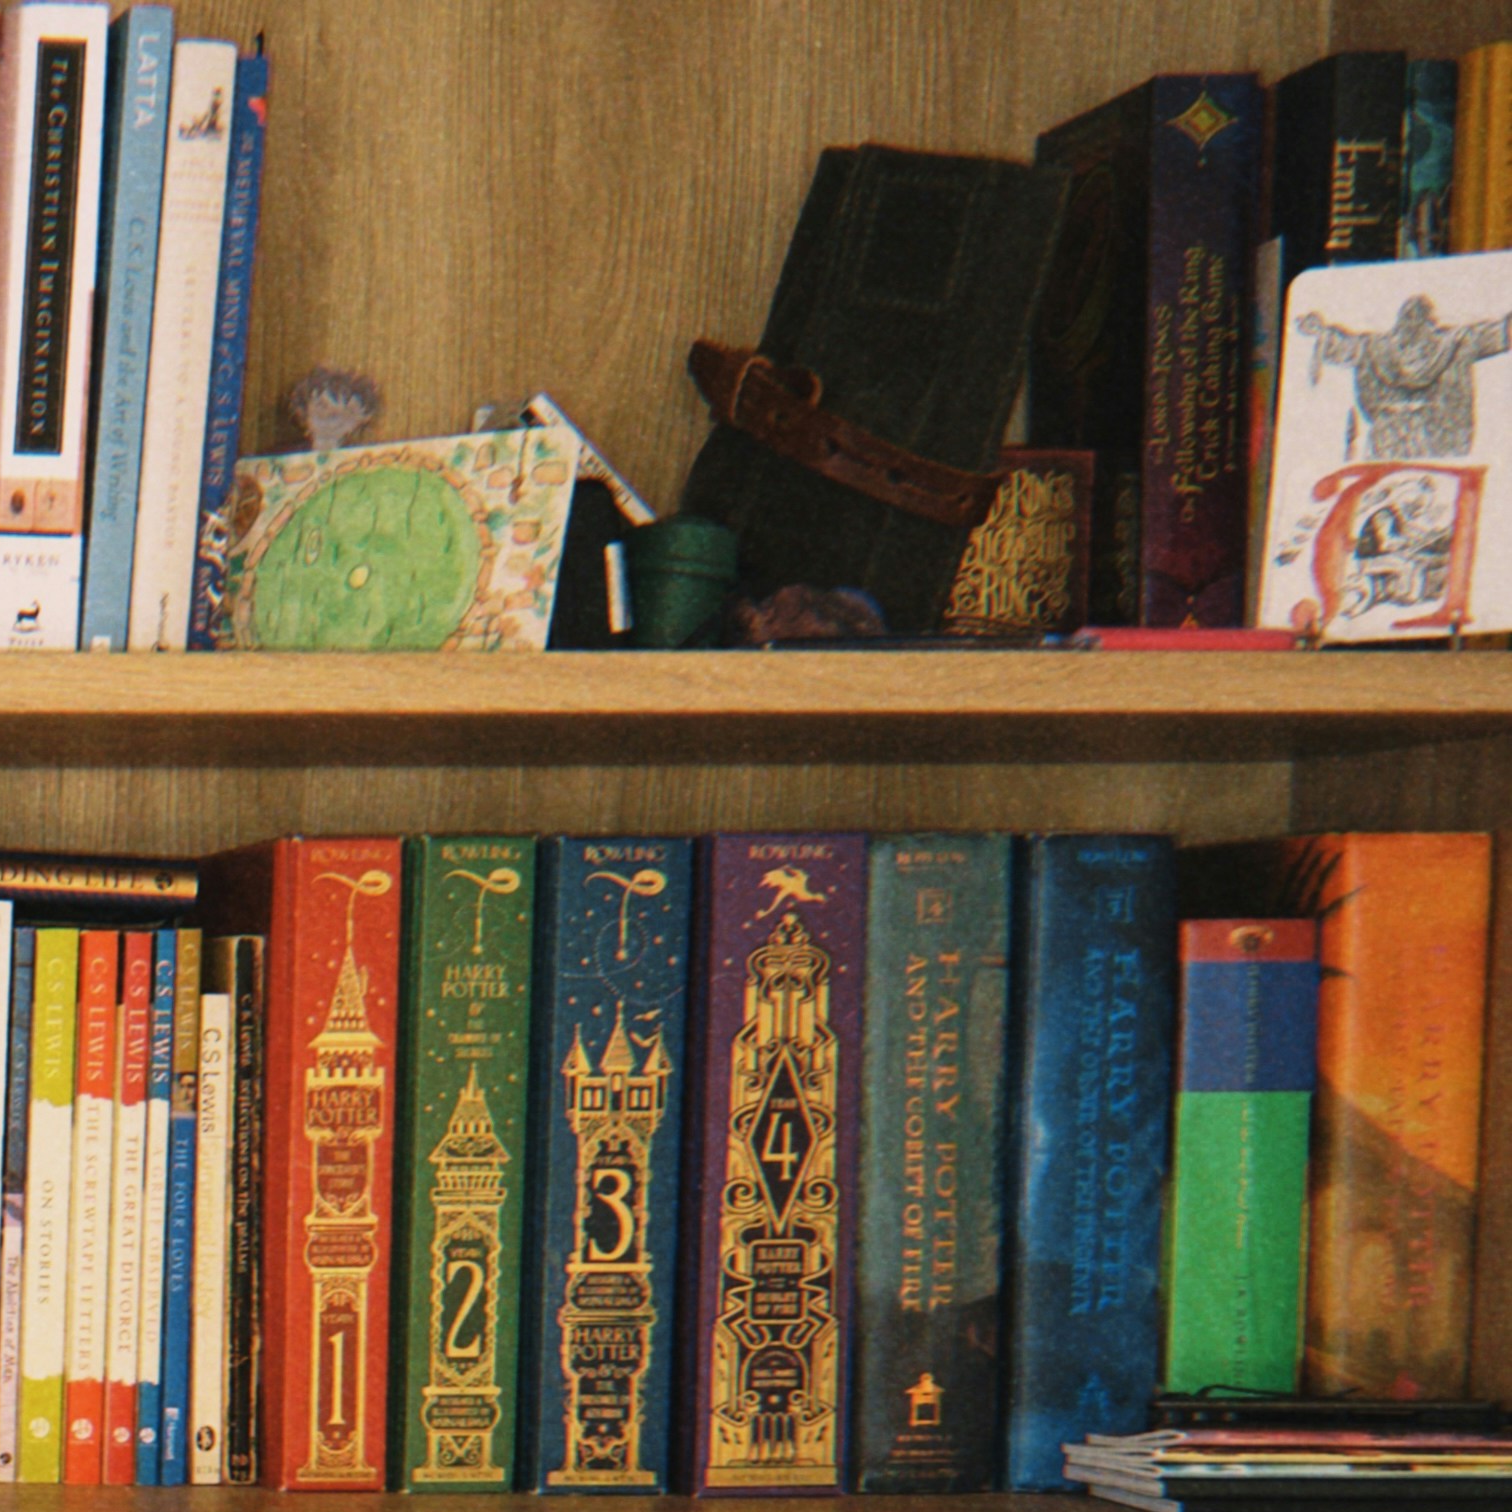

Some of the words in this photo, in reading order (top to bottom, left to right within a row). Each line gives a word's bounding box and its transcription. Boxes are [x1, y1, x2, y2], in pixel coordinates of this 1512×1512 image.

[441, 980, 509, 999] POTTER
[444, 964, 506, 982] HARRY
[760, 1115, 797, 1181] 4
[589, 1168, 631, 1261] 3
[444, 1261, 485, 1358] 2
[327, 1331, 346, 1425] 1
